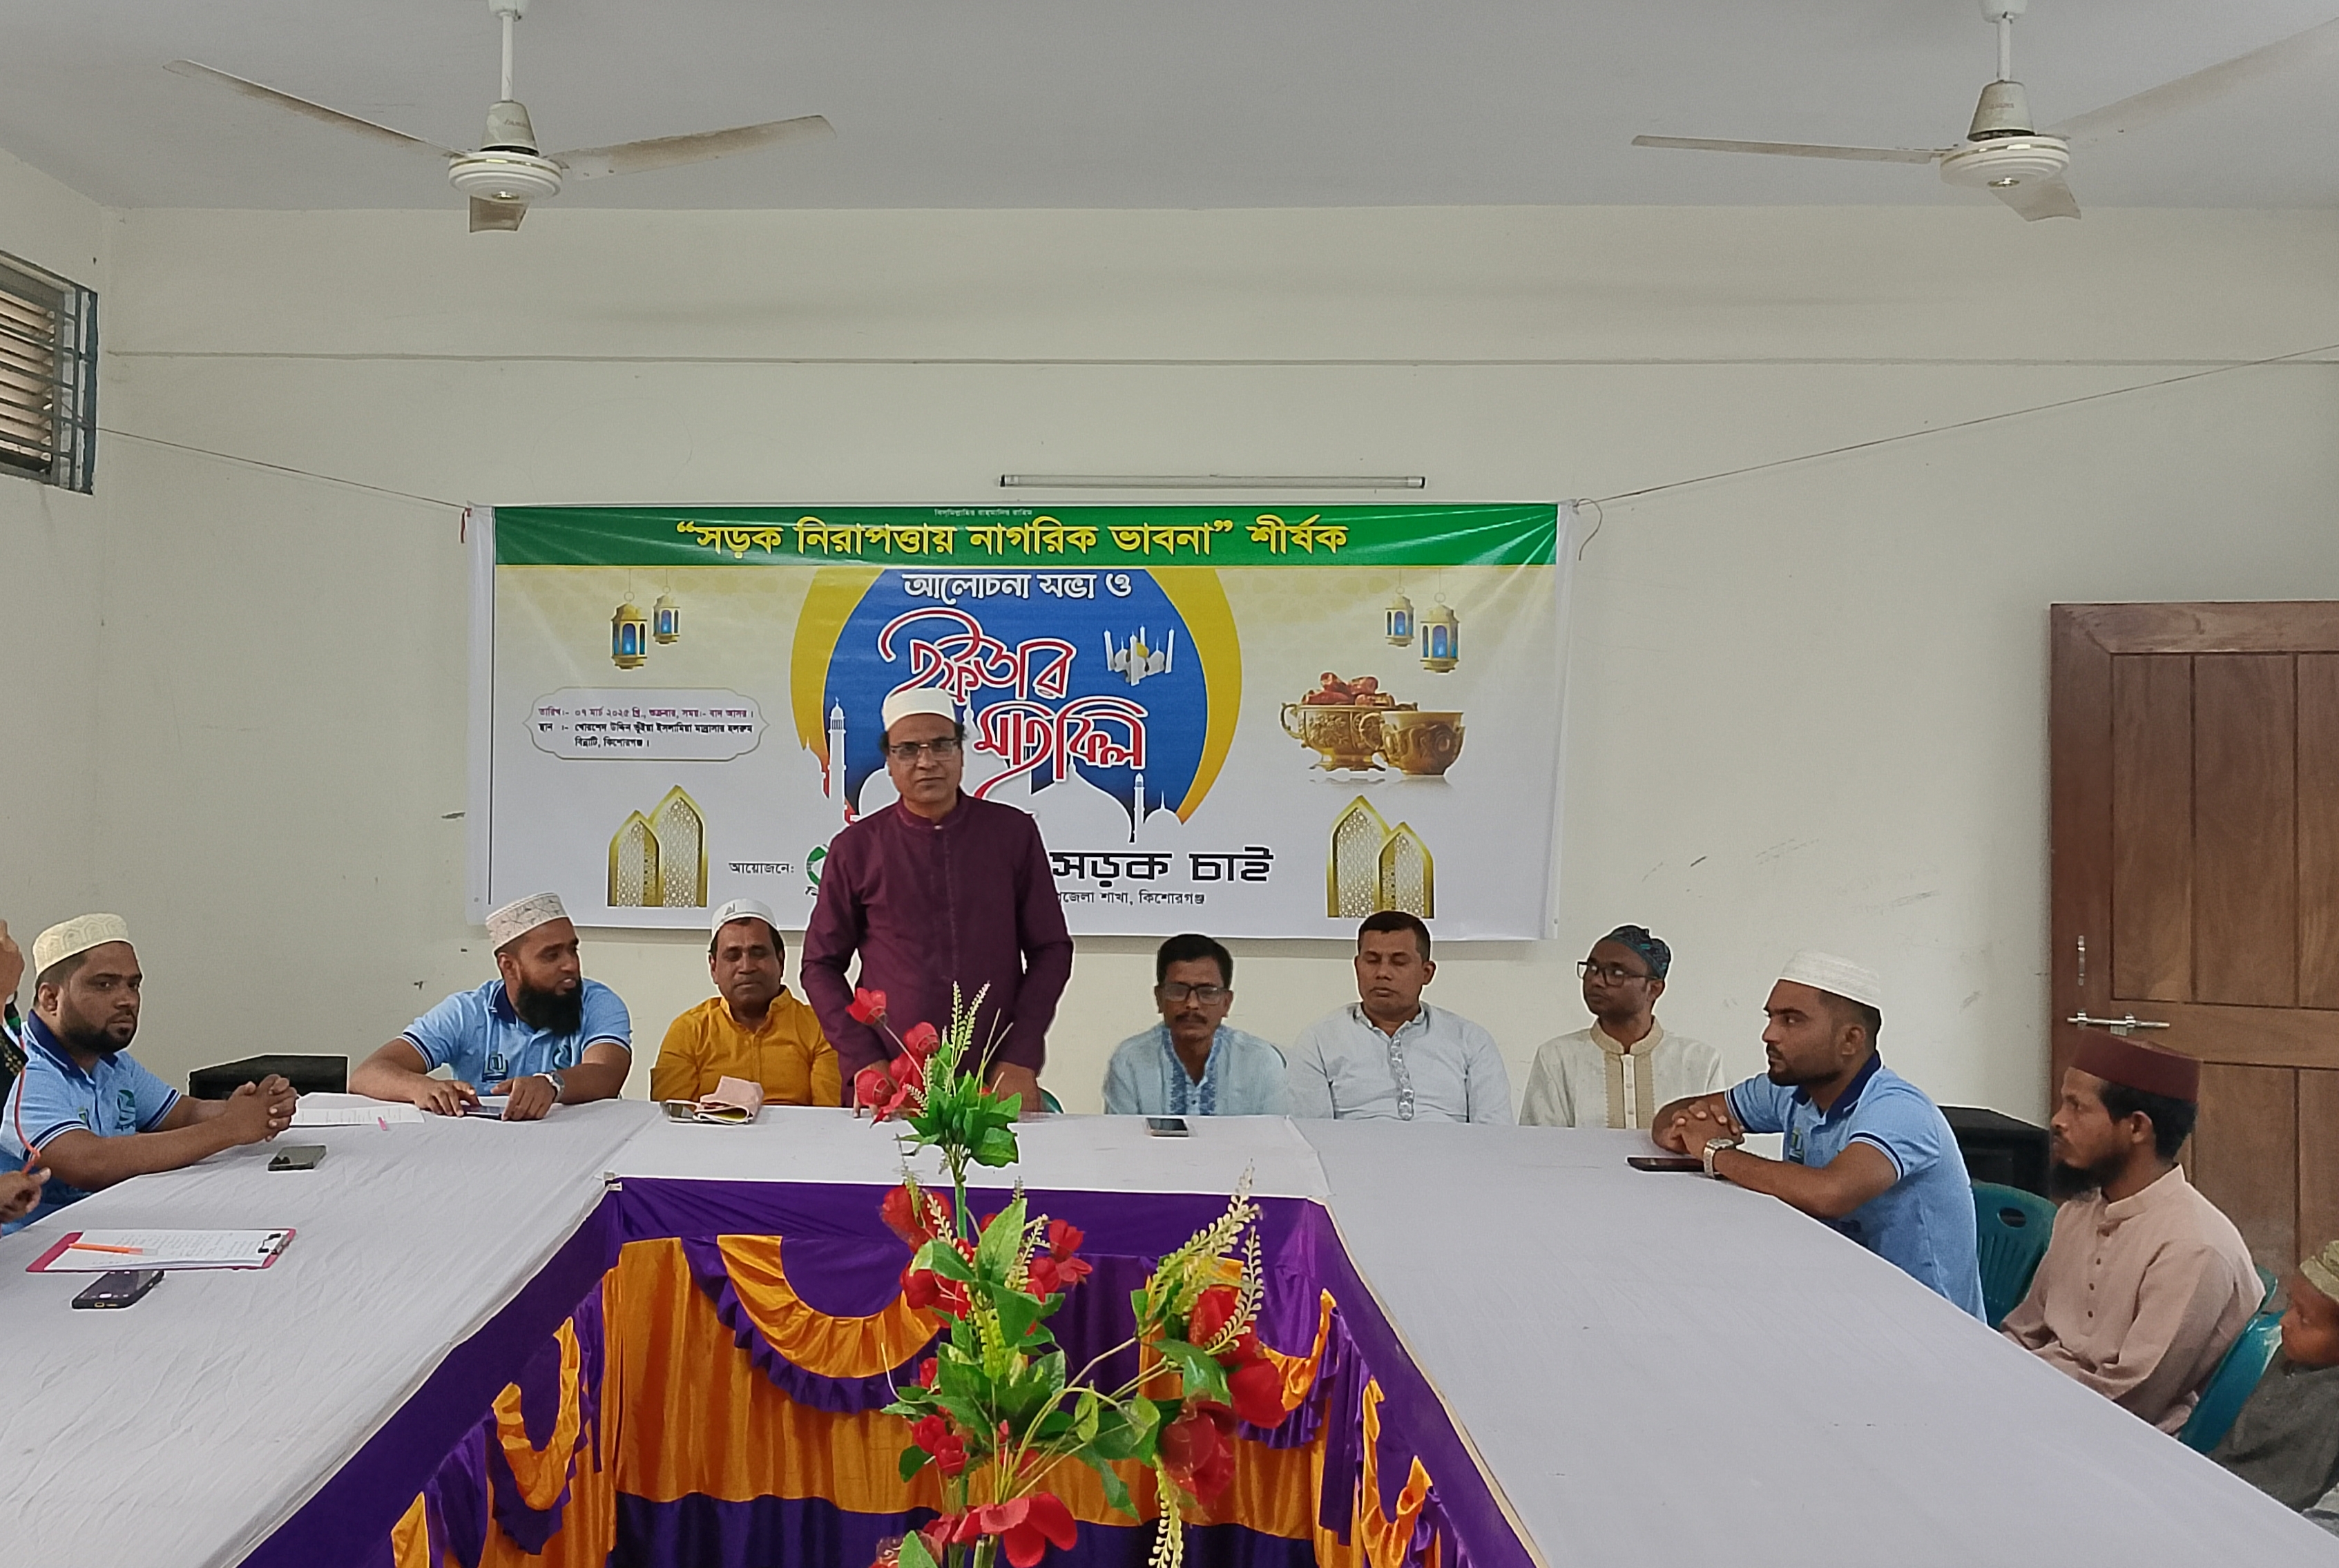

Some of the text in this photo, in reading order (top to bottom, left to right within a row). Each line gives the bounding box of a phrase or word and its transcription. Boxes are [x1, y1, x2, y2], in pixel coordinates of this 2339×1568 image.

[676, 514, 1349, 559] “সড়ক নিরাপত্তায় নাগরিক ভাবনা” শীর্ষক
[901, 572, 1133, 606] আলোচনা সভা ও
[878, 607, 1077, 706] ইফতার
[539, 723, 553, 733] স্থান
[589, 706, 604, 717] মার্চ
[606, 708, 630, 717] ২০২৫
[725, 709, 747, 718] আসর
[973, 695, 1148, 800] মাহফিল
[1049, 846, 1274, 888] সড়ক চাই
[1057, 889, 1205, 906] জেলা শাখা, কিশোরগঞ্জ
